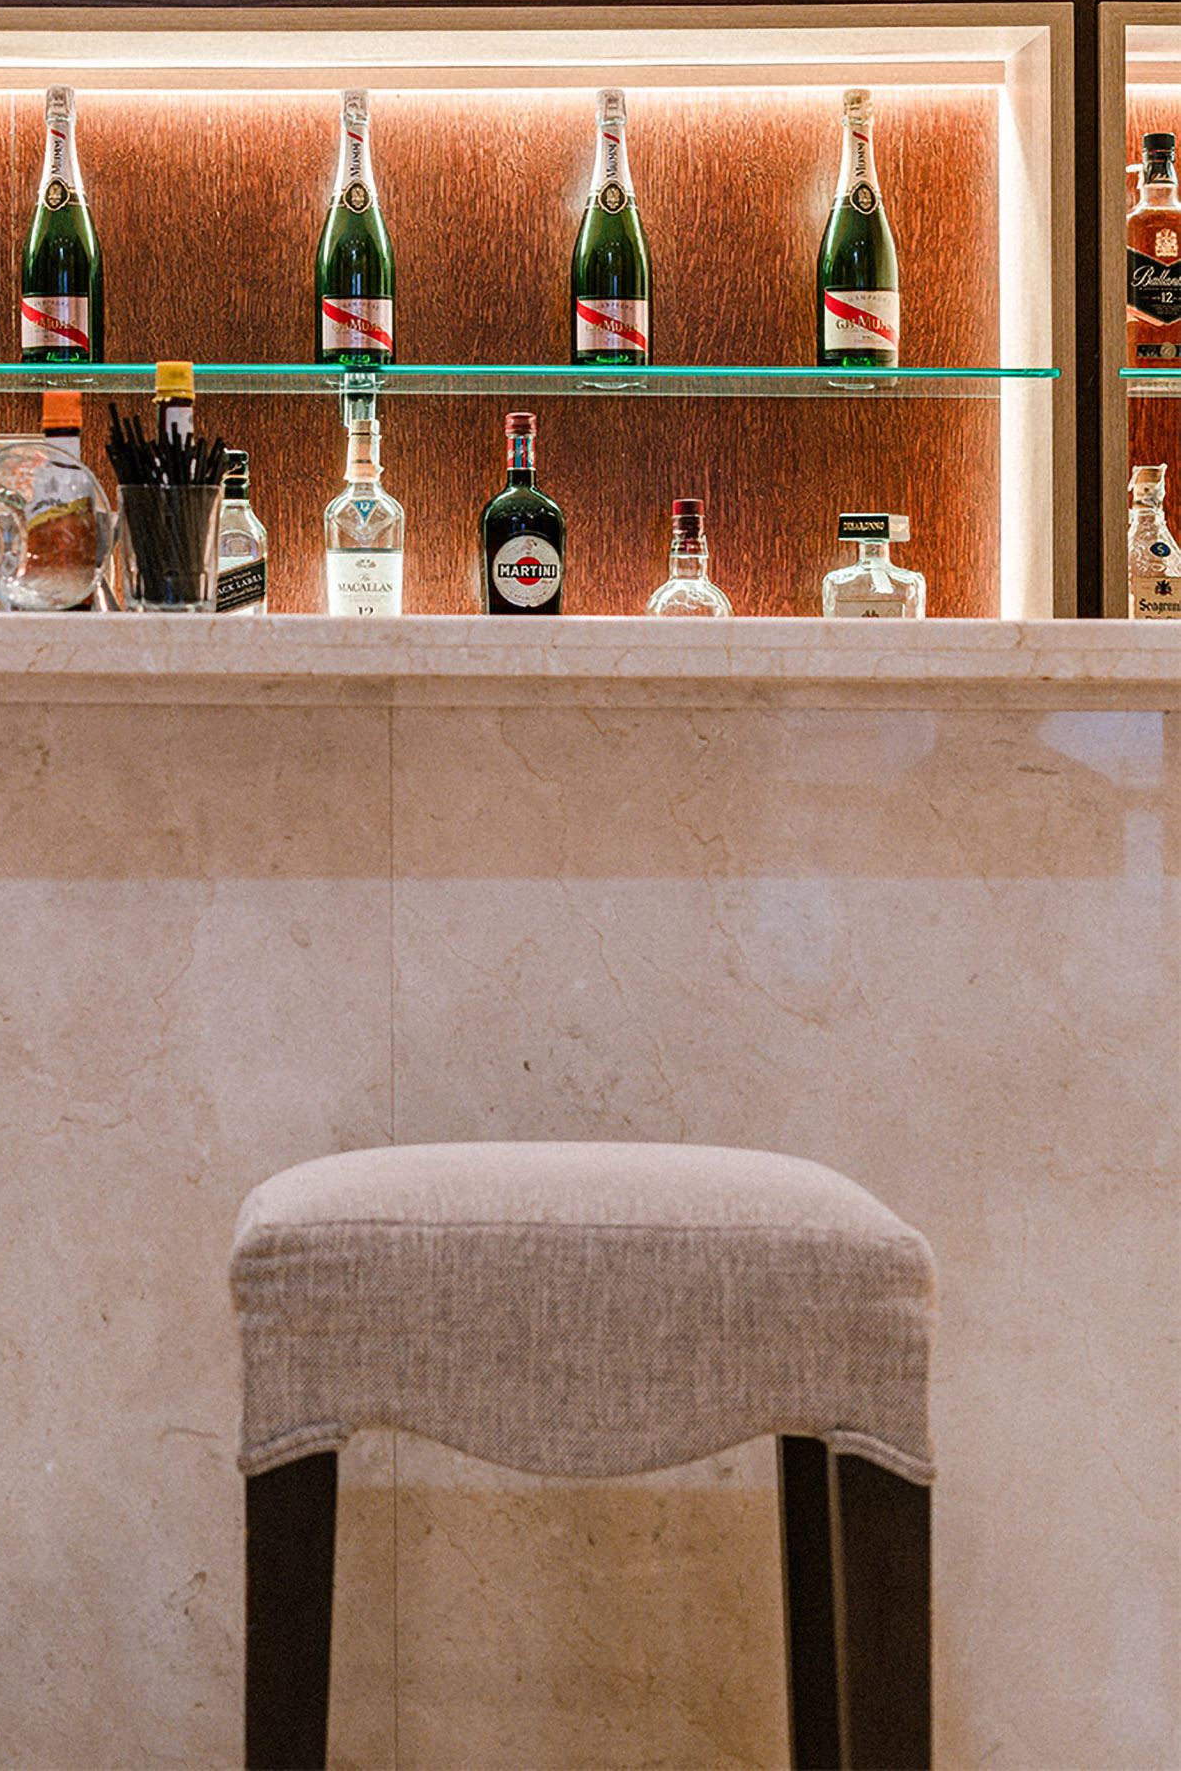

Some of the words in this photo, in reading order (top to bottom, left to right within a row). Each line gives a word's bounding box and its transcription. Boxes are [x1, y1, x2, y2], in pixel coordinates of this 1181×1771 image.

[1161, 291, 1174, 303] 12
[360, 501, 371, 512] 12
[499, 565, 557, 577] MARTINI
[337, 582, 394, 593] MACALLAN
